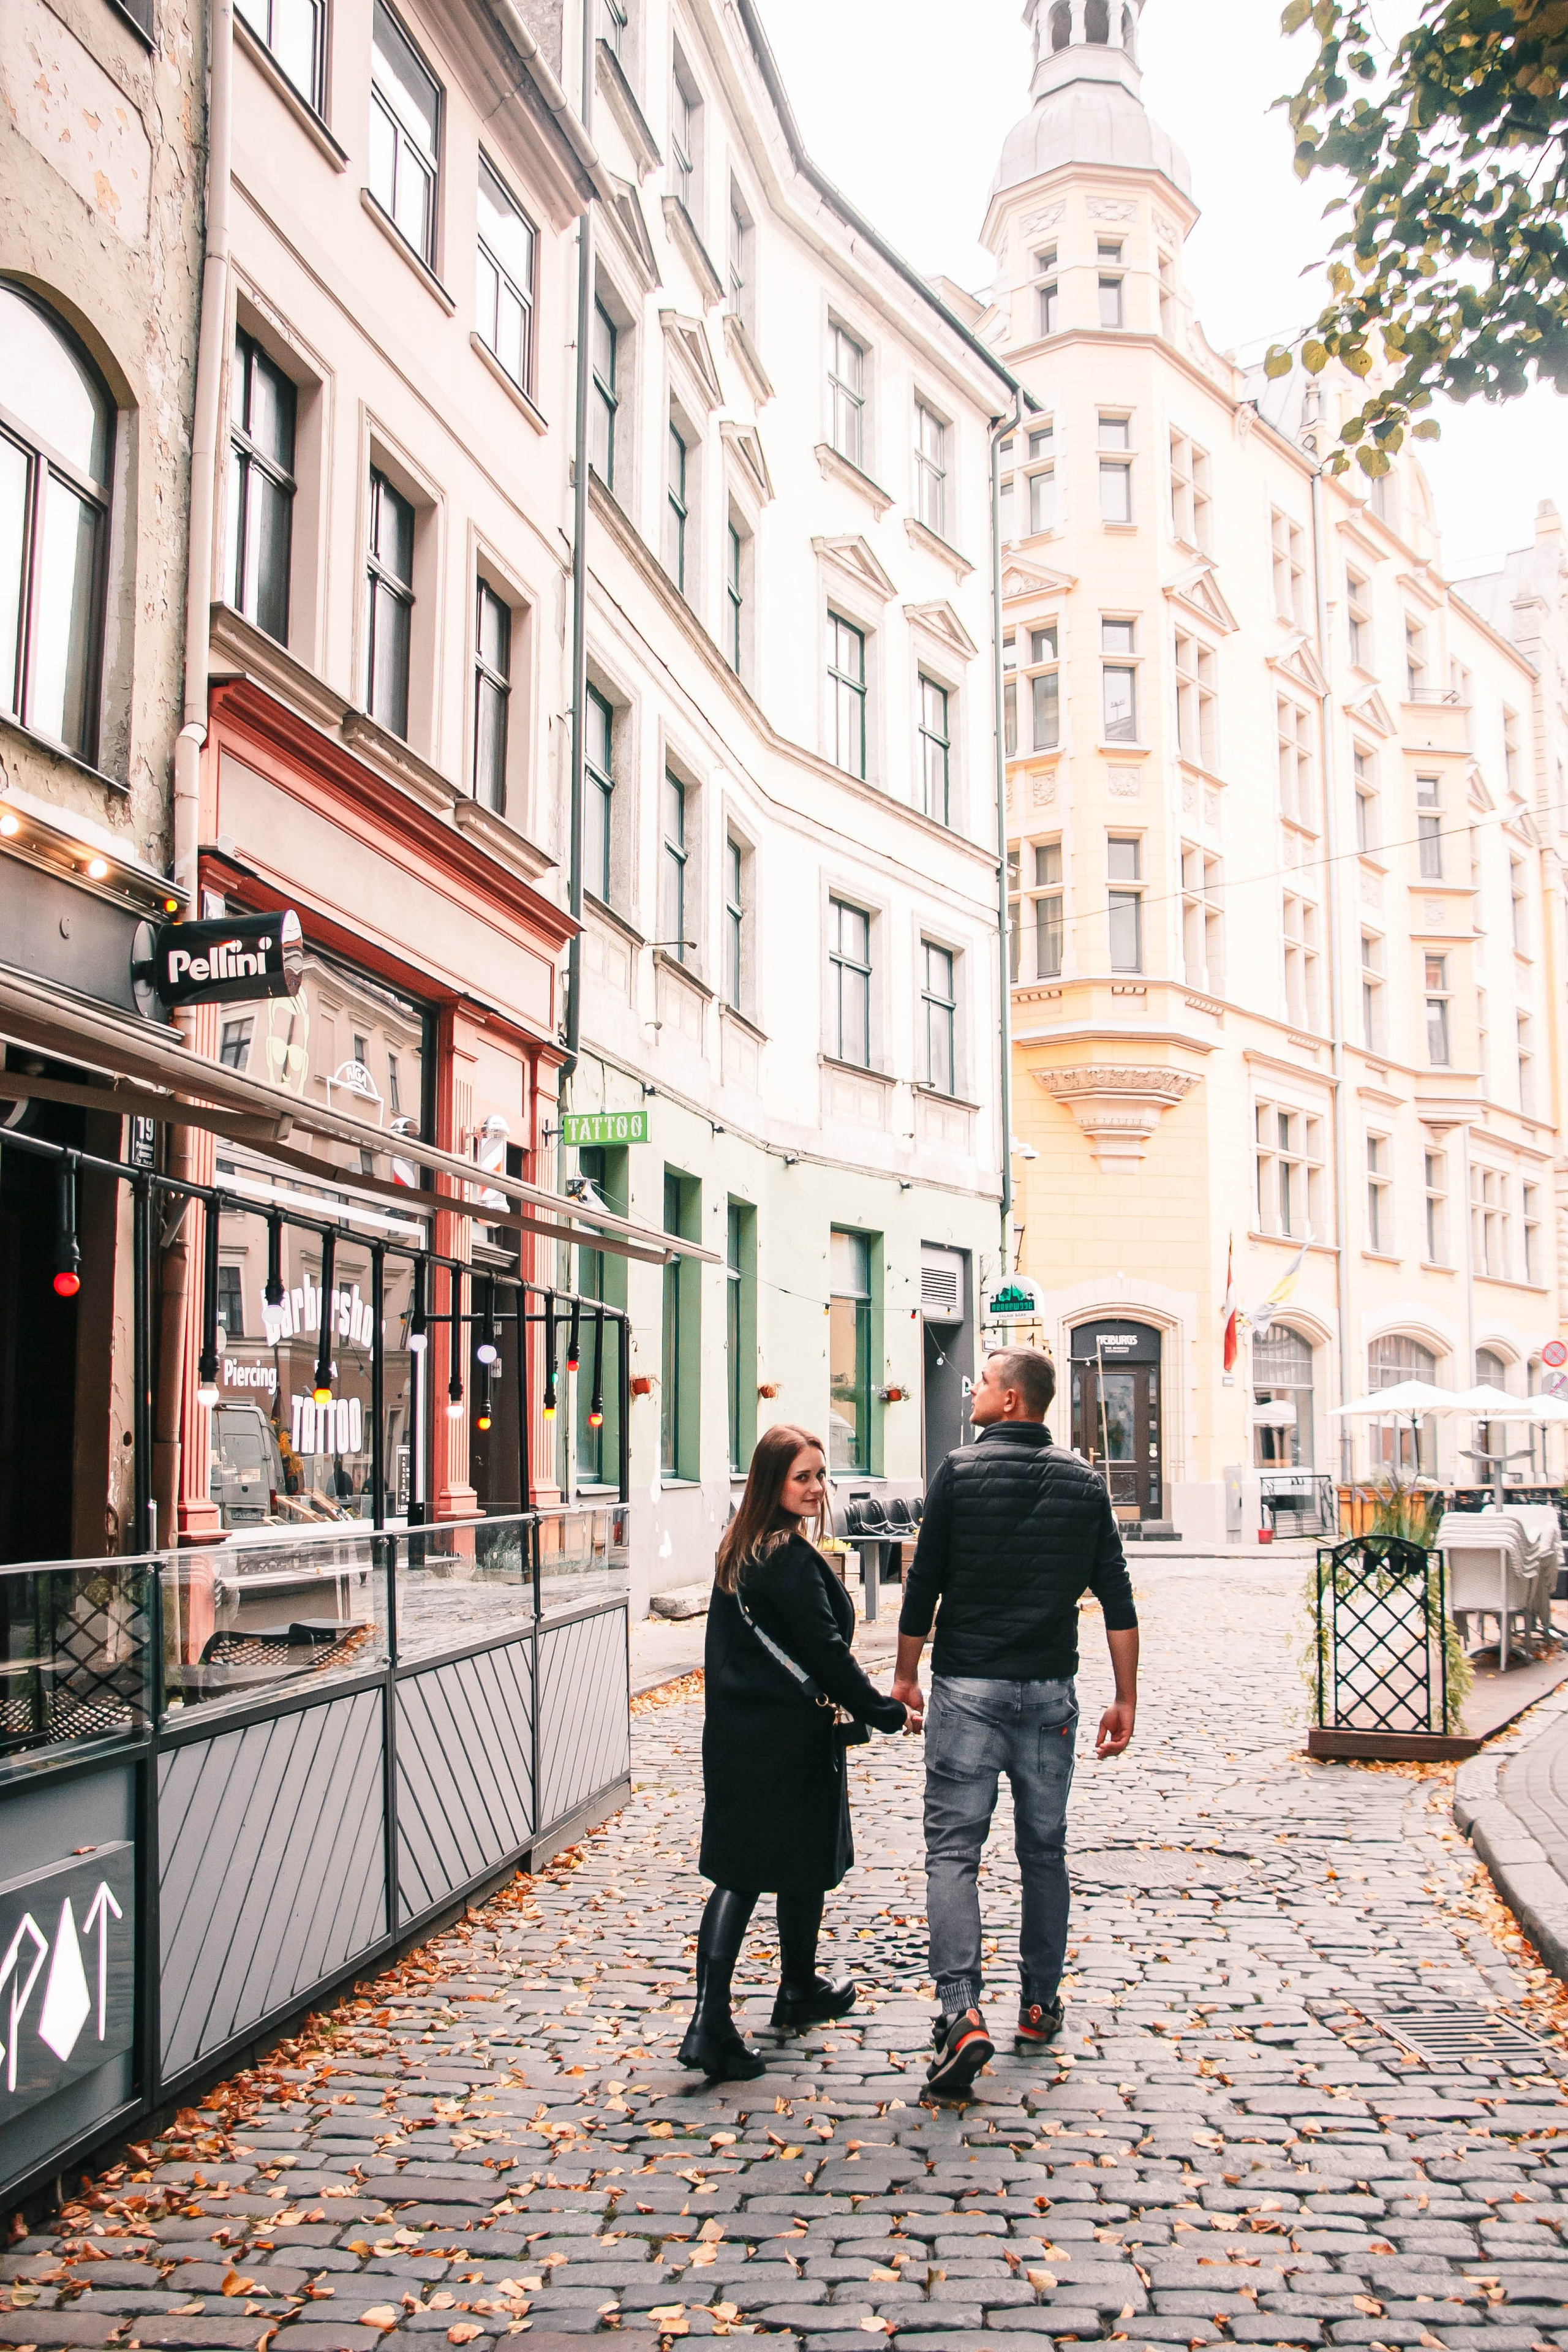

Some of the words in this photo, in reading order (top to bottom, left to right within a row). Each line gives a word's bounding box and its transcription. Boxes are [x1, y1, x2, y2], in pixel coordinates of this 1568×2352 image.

[168, 937, 272, 983] Pellini
[137, 1116, 154, 1141] 19
[568, 1115, 643, 1140] TATTOO
[224, 1359, 277, 1395] Piercing
[292, 1395, 361, 1454] TATTOO
